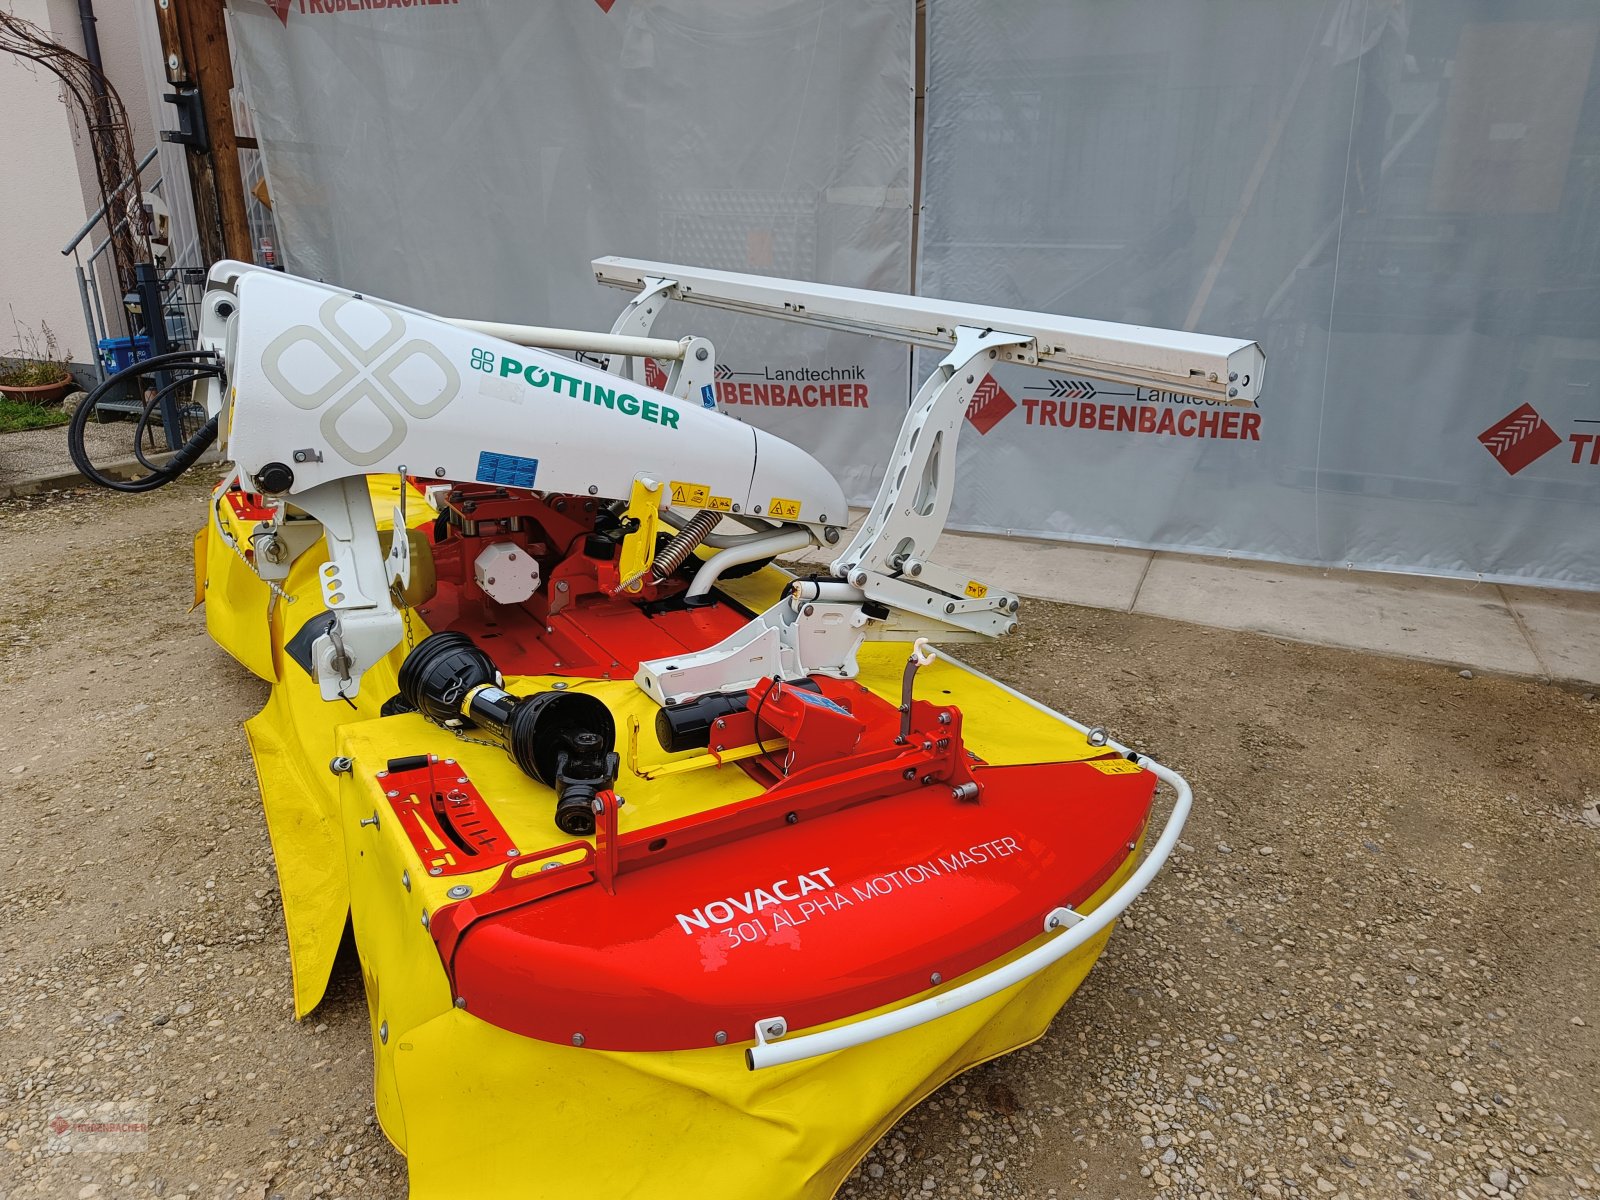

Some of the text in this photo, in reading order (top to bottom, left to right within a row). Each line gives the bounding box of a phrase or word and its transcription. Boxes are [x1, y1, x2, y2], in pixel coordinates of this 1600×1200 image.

[765, 365, 866, 382] Landtechnik
[1021, 398, 1262, 441] TRUBENBACHER
[675, 866, 837, 936] NOVACAT
[720, 835, 1024, 949] 301 ALPHA MOTION MASTER
